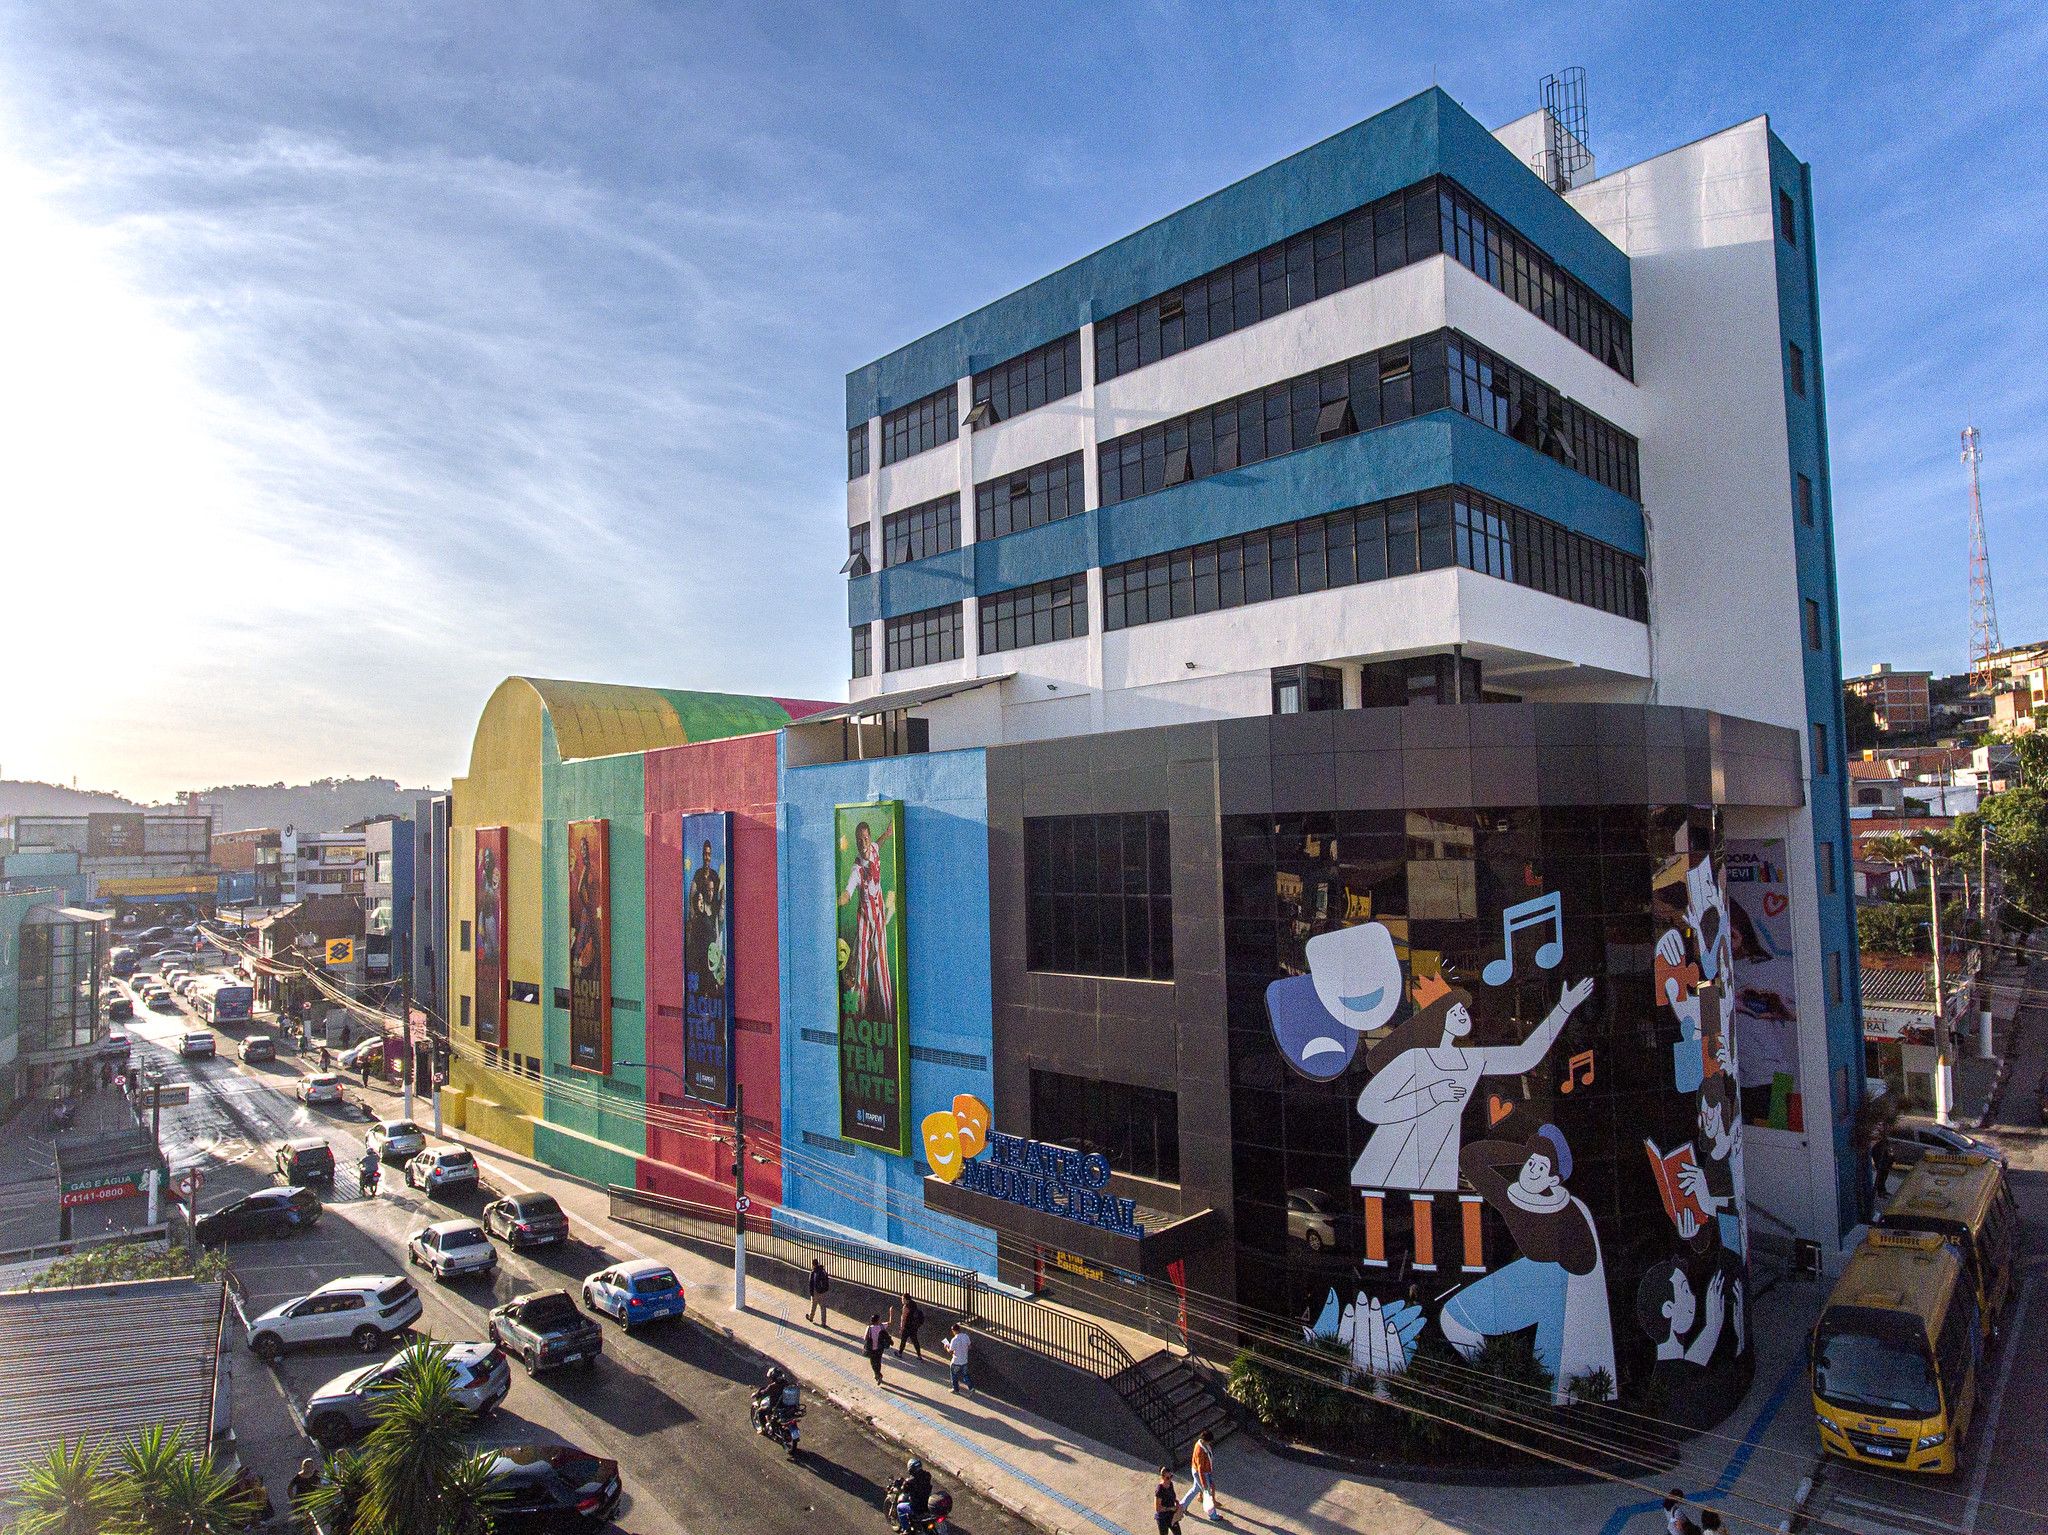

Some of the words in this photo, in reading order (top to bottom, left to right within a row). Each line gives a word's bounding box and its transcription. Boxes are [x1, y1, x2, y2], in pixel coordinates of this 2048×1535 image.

[687, 994, 721, 1019] AQUI
[687, 1016, 716, 1041] TEM
[843, 1018, 893, 1049] AQUI
[688, 1040, 722, 1067] ARTE
[843, 1043, 884, 1074] TEM
[845, 1072, 895, 1104] ARTE
[986, 1129, 1112, 1189] TEATRO
[71, 1187, 123, 1203] 4141-0800
[963, 1158, 1145, 1240] MUNICIPAL
